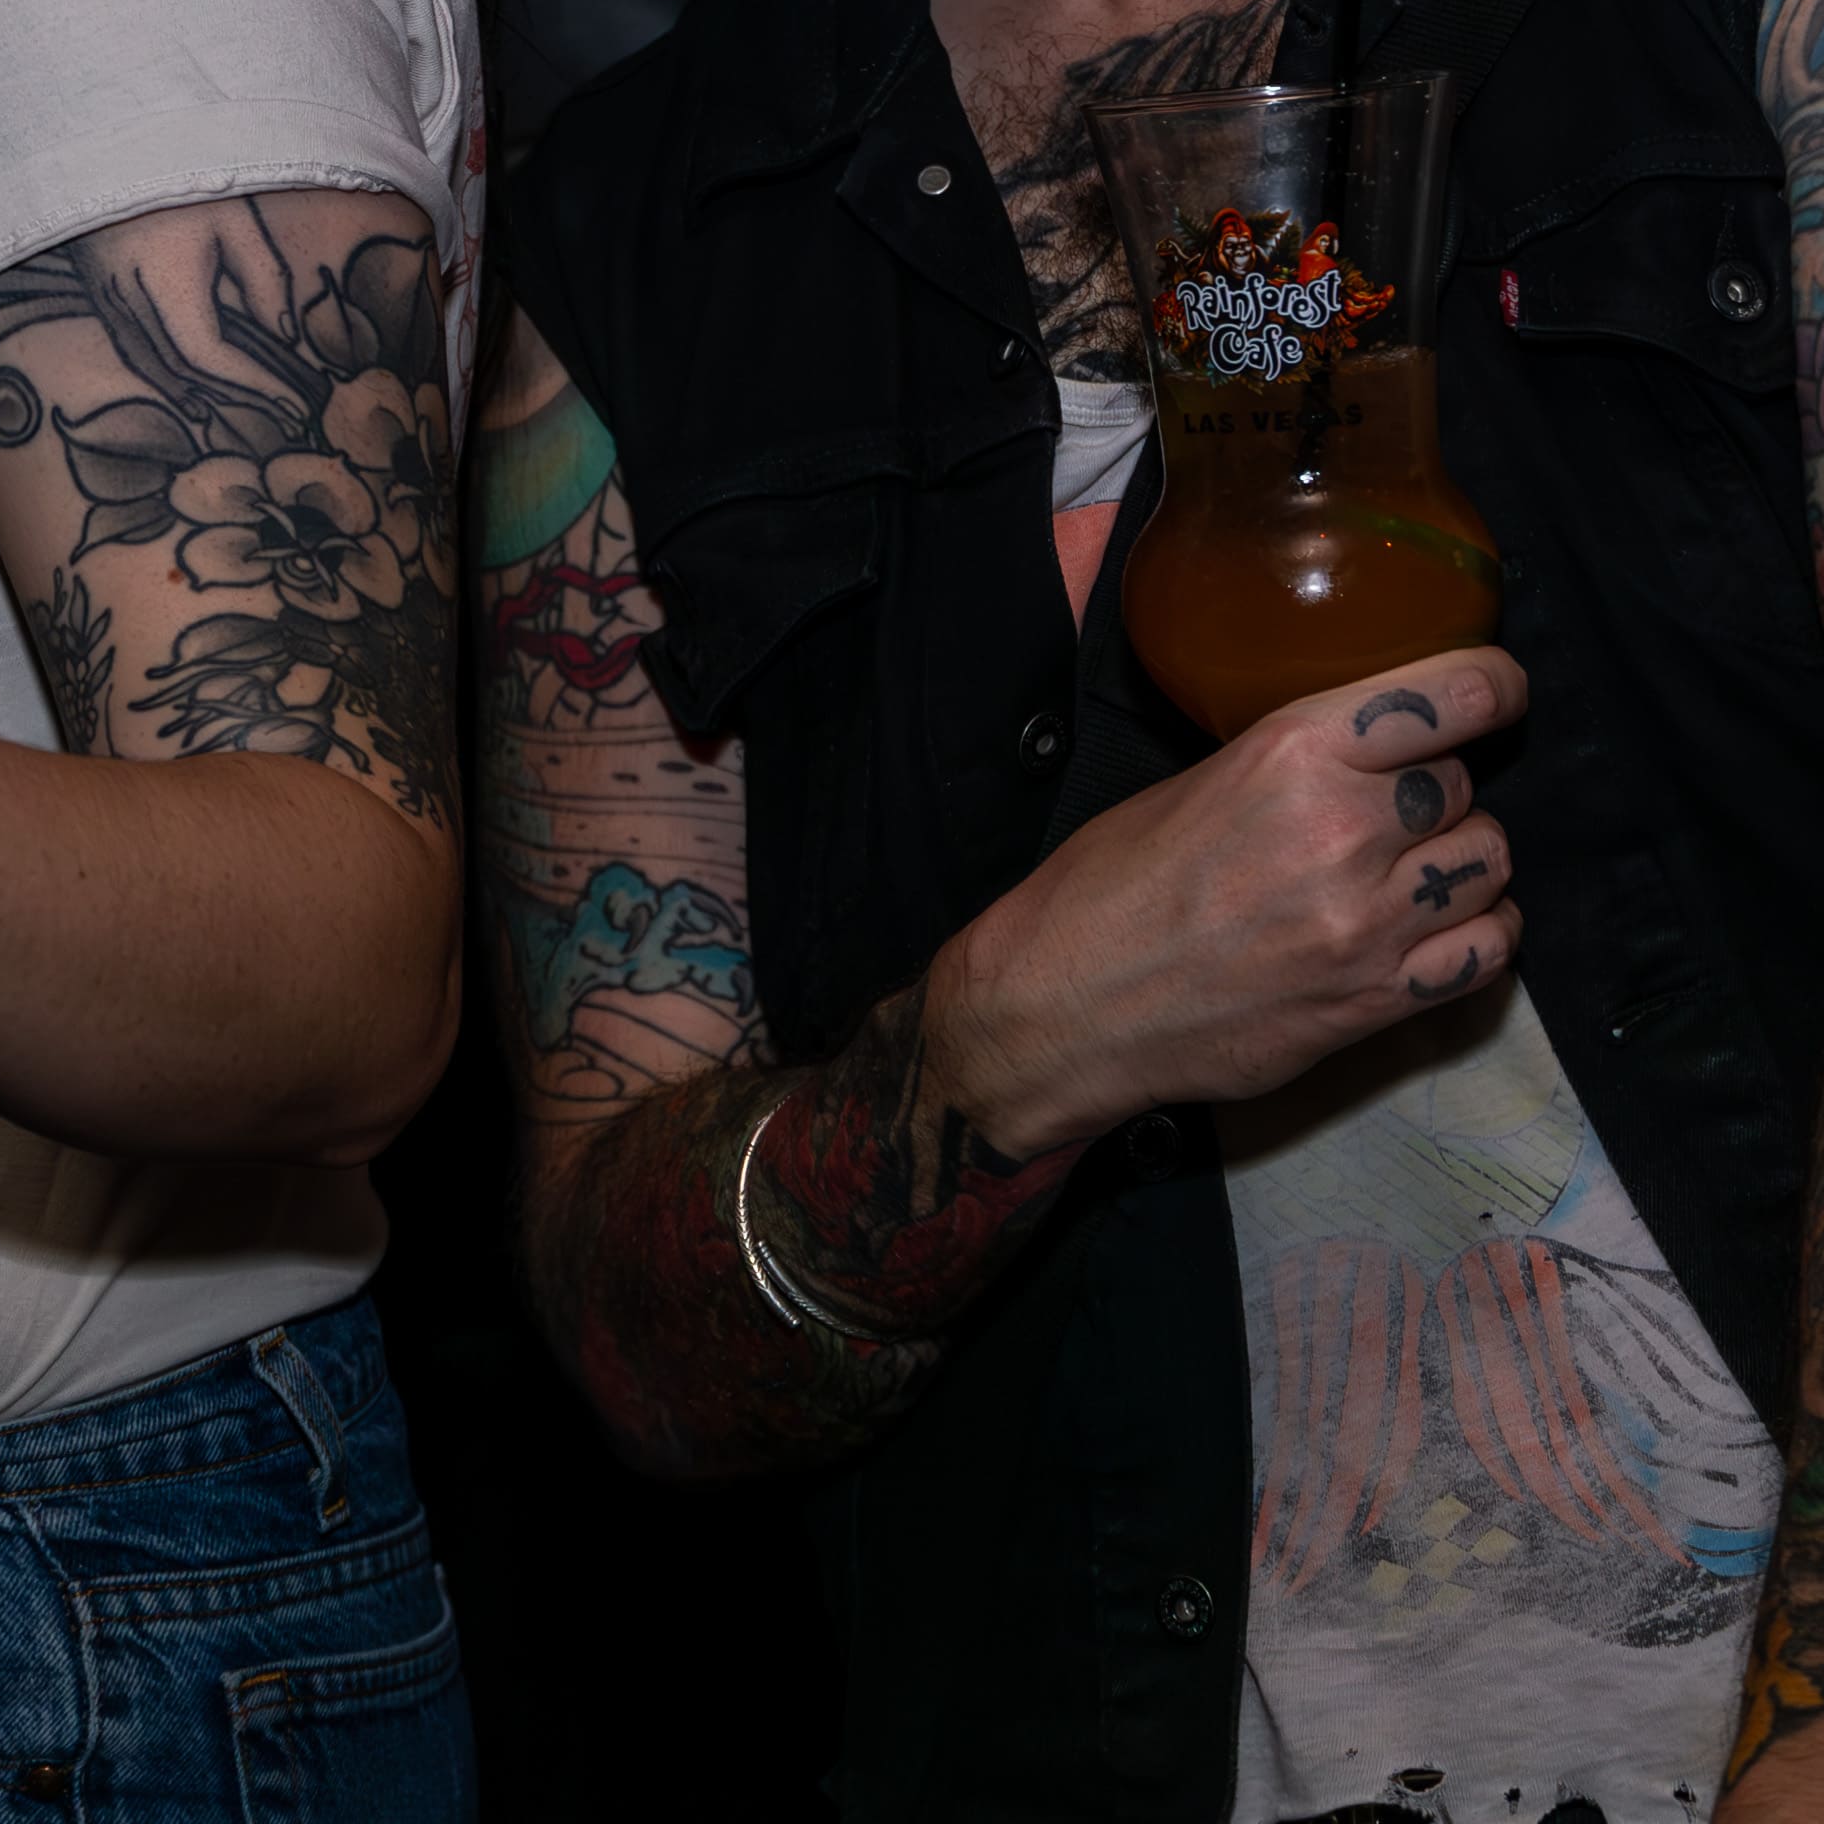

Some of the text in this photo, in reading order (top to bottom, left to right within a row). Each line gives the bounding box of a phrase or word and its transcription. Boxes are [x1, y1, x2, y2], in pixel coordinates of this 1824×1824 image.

[1176, 269, 1342, 330] Rainforest
[1209, 323, 1303, 381] Cafe
[1183, 403, 1363, 434] LAS VEAS
